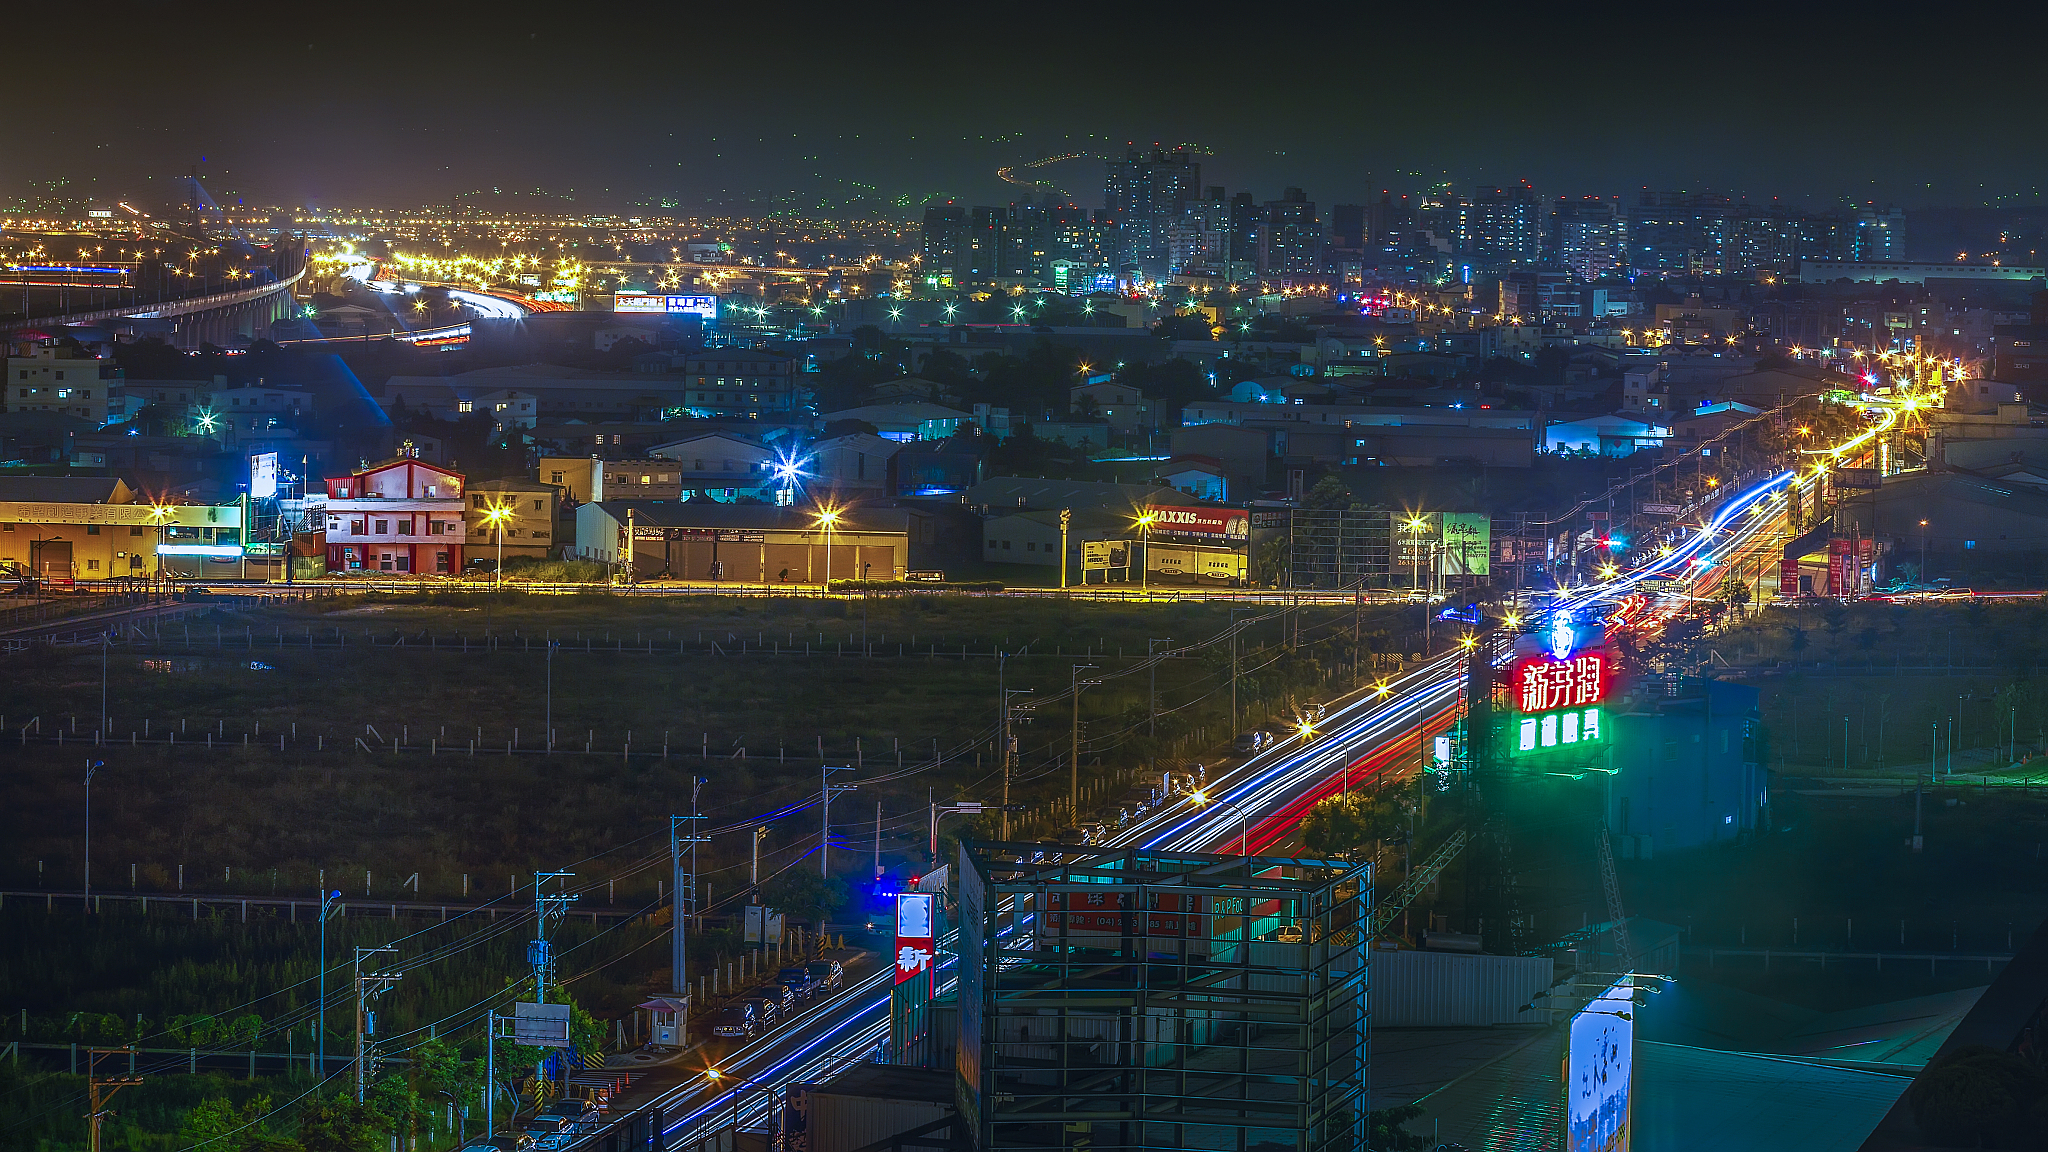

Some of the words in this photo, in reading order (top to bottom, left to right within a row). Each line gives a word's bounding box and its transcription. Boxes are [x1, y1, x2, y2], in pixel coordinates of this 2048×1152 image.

[18, 504, 147, 520] 希望創造事業有限公
[1096, 916, 1115, 927] (04)
[897, 946, 933, 972] 新
